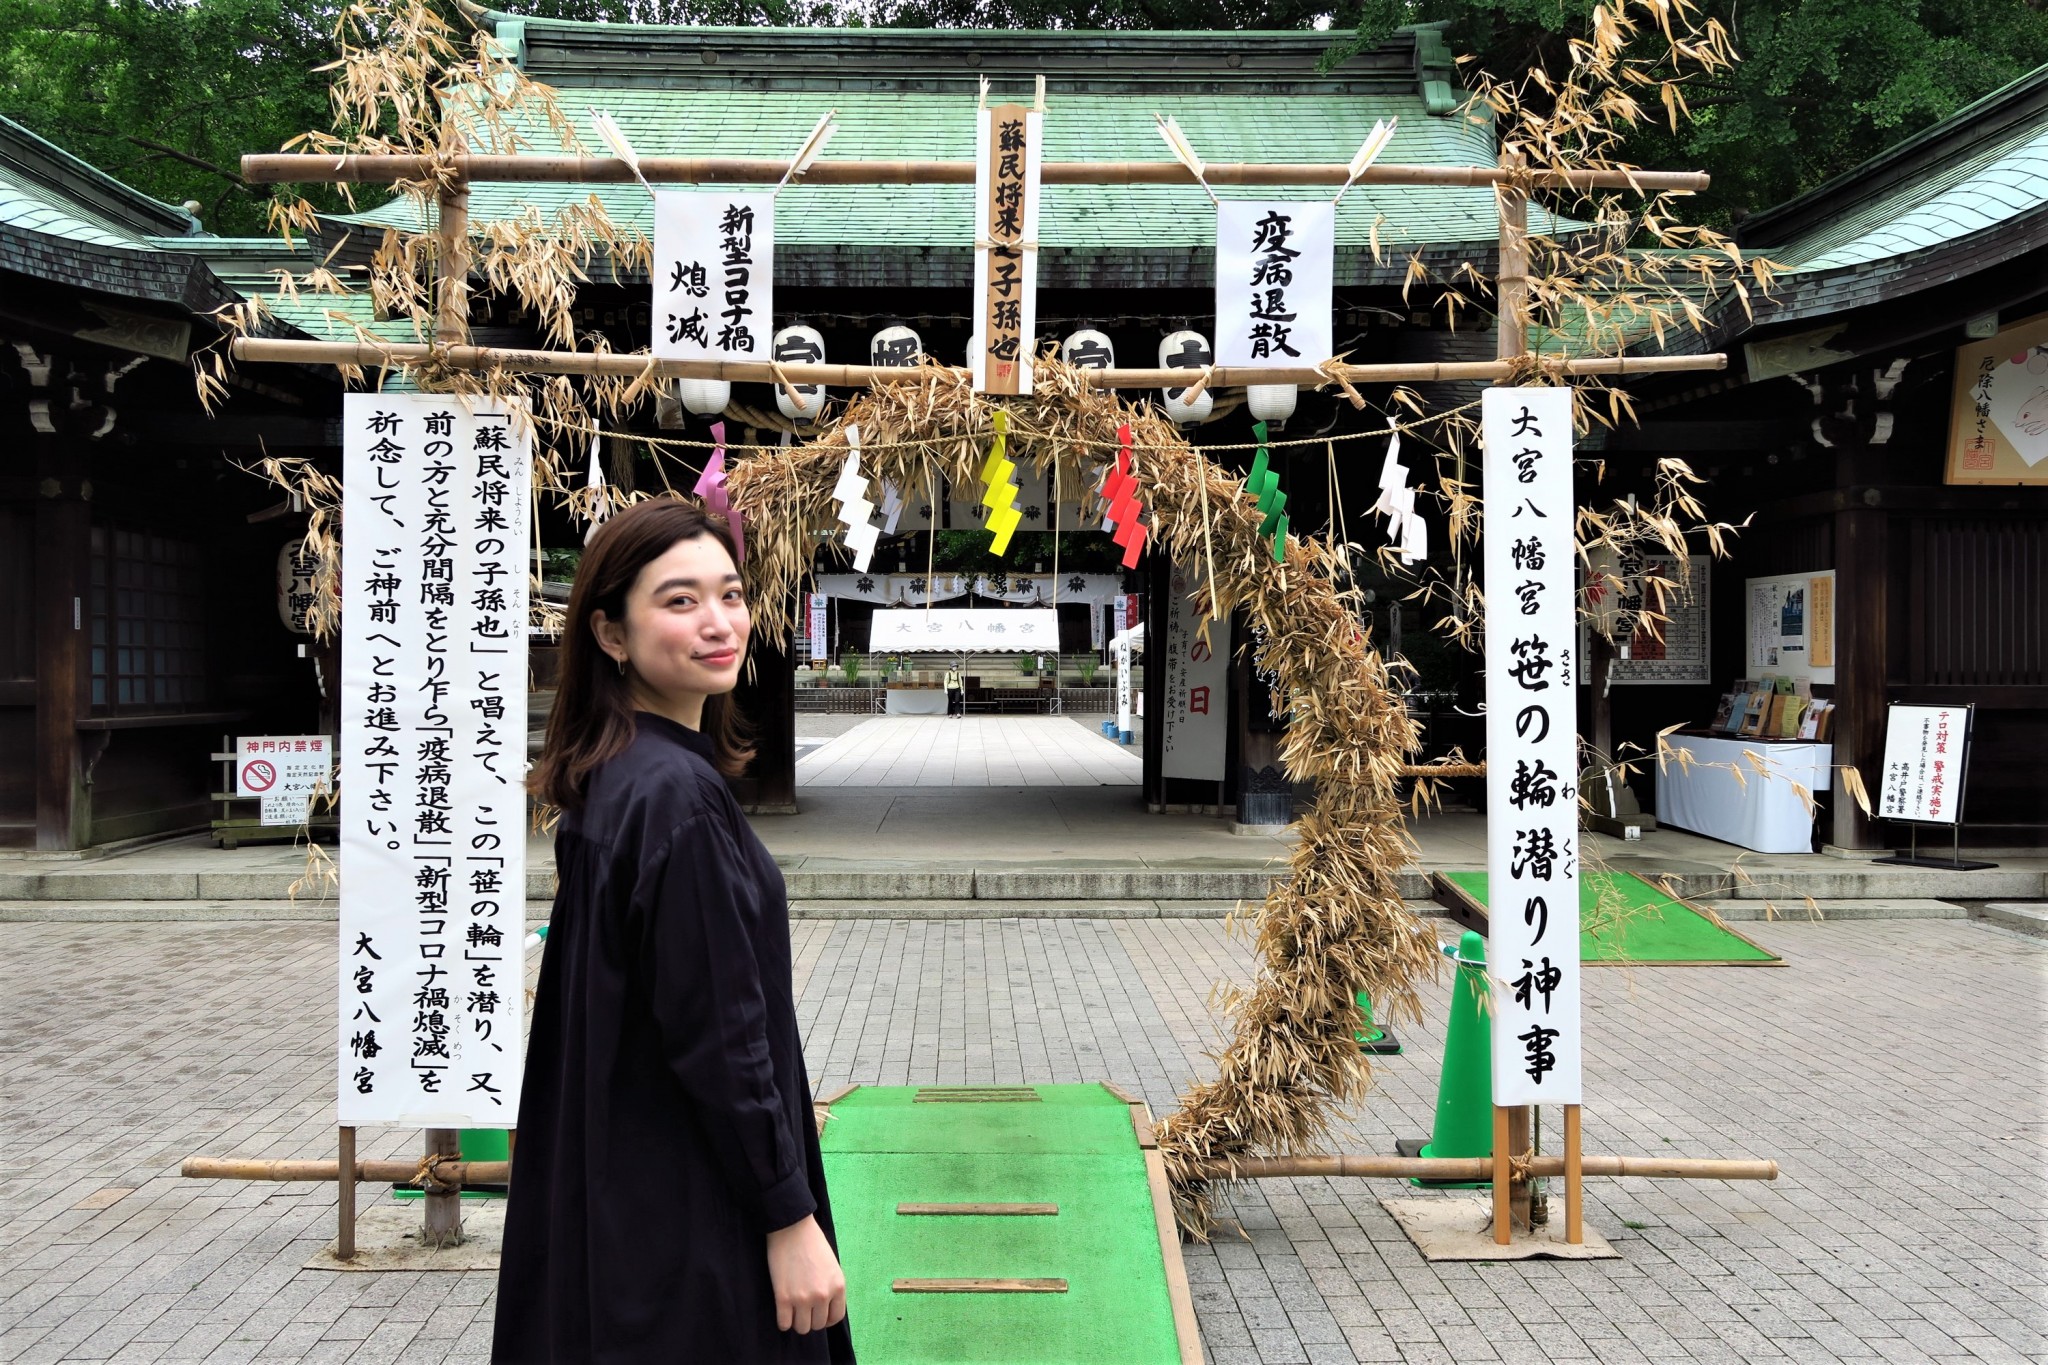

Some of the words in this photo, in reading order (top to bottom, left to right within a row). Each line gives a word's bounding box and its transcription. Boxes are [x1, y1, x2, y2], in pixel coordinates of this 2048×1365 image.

[716, 204, 754, 352] 新型コロナ禍
[1248, 211, 1301, 359] 疫病退散
[666, 261, 710, 348] 熄滅
[1974, 355, 1995, 449] 厄除八幡さま
[896, 619, 1036, 634] 大宮八幡宮
[1560, 649, 1570, 686] ささ
[246, 740, 323, 753] 神門内禁煙
[1935, 711, 1950, 754] テロ対策
[284, 782, 327, 791] 大宮八幡
[1561, 782, 1575, 799] わ
[1886, 761, 1898, 814] 大宮八幡宮
[1896, 762, 1909, 814] 高井戸警察署
[1929, 760, 1944, 819] 警戒実施中
[1563, 838, 1576, 879] くぐ
[351, 932, 383, 1094] 大宮八幡宮
